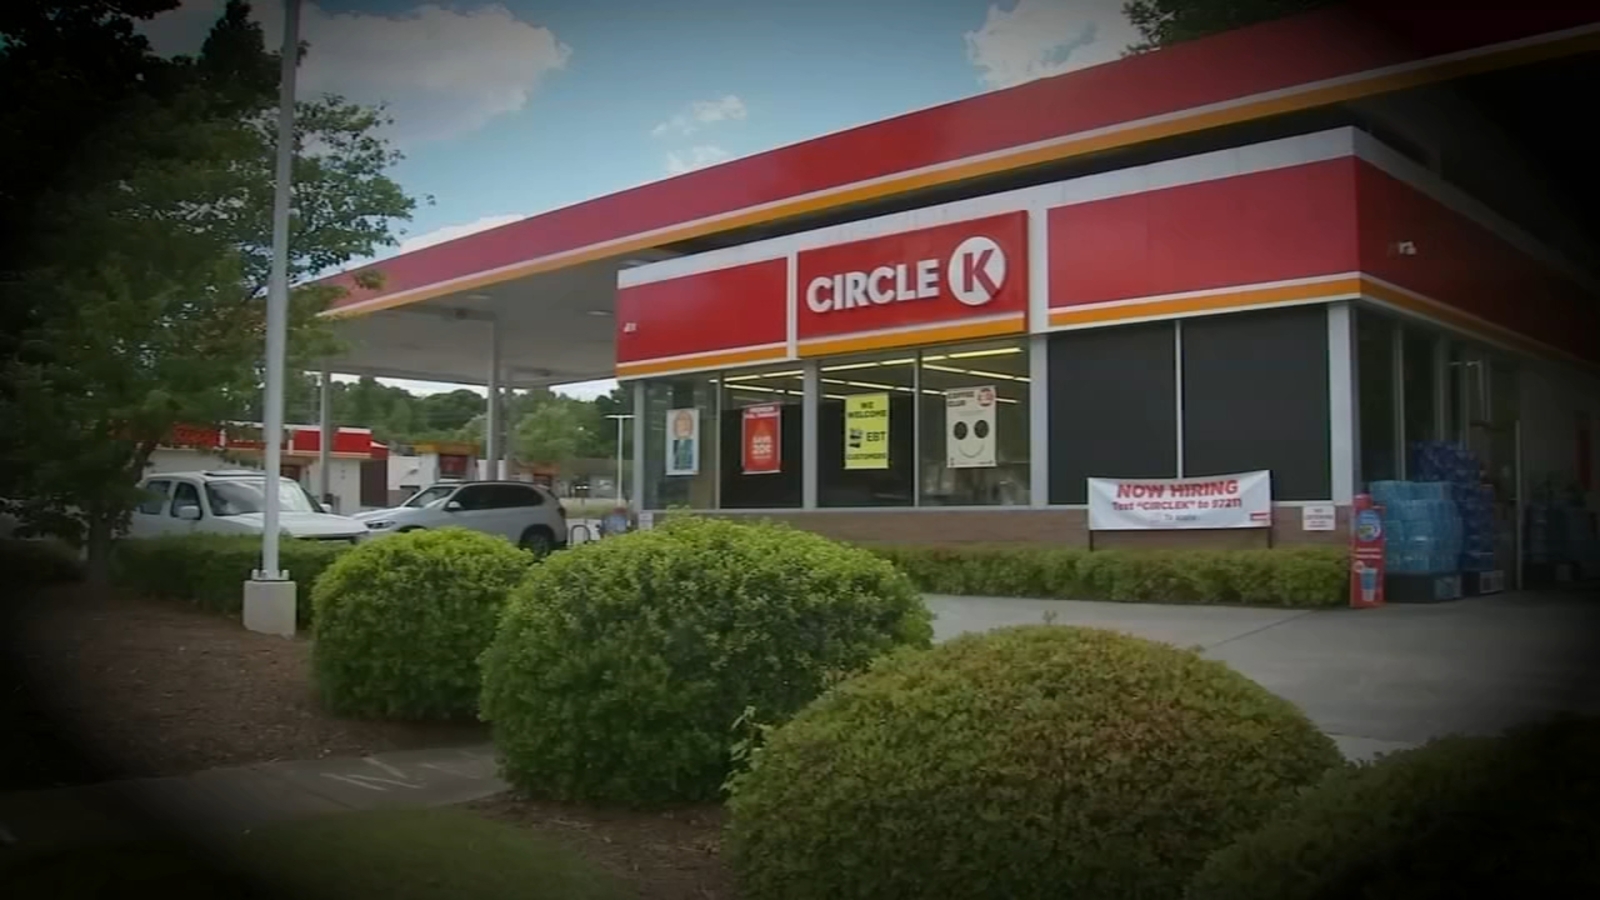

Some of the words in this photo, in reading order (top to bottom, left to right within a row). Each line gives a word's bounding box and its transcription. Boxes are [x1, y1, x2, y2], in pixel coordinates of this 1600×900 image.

[806, 258, 941, 314] CIRCLE
[961, 246, 1001, 300] K
[860, 401, 875, 410] WE
[847, 409, 887, 418] WELCOME
[866, 430, 887, 442] EBT
[846, 452, 887, 460] CUSTOMERS
[1116, 483, 1165, 499] NOW
[1170, 479, 1239, 497] HIRING
[1112, 501, 1134, 511] Text
[1198, 500, 1209, 509] to
